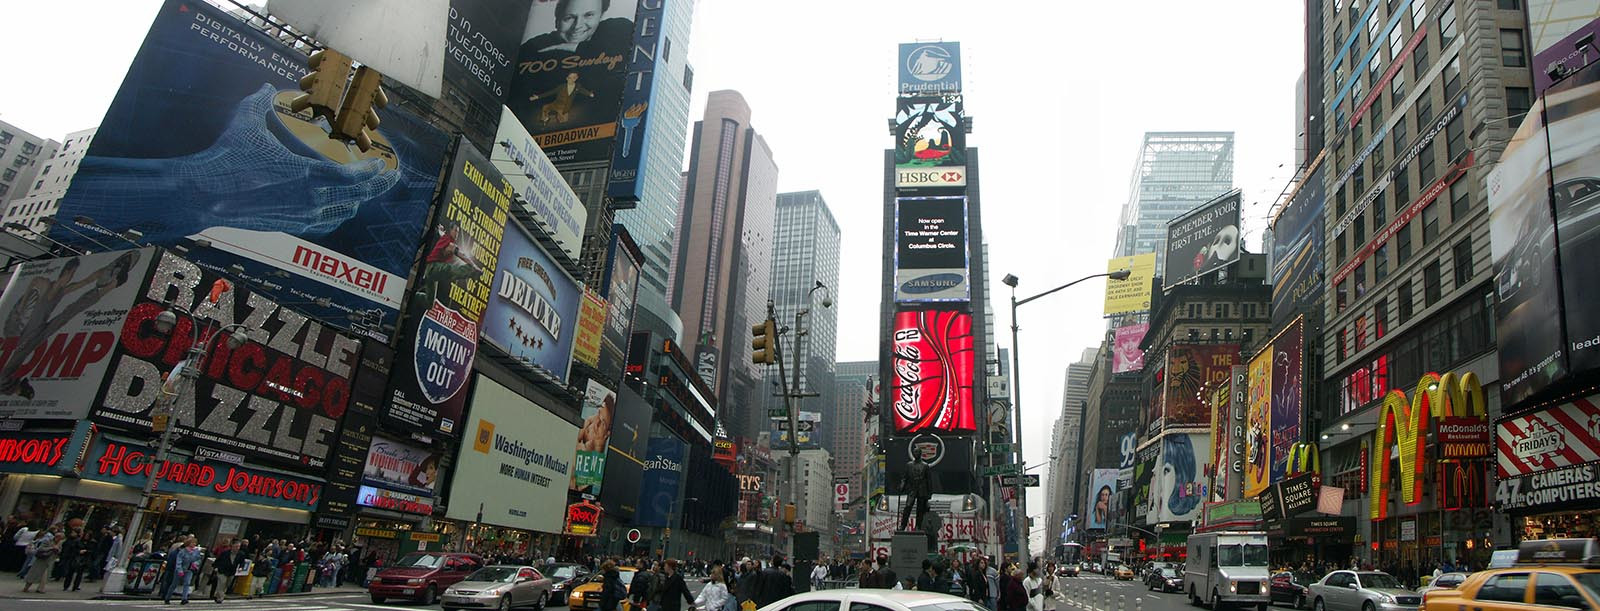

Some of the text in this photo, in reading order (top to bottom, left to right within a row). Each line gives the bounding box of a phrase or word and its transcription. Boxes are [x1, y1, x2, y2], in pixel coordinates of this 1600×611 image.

[195, 13, 264, 52] DIGITALLY
[460, 17, 471, 33] IN
[472, 32, 510, 67] STORES
[190, 22, 297, 82] PERFORMANCE.
[450, 24, 495, 74] TUESDAY,
[519, 52, 623, 74] 700 Sundays
[493, 82, 502, 96] 16
[901, 81, 959, 91] Prudential
[941, 95, 961, 103] 1:34
[544, 127, 600, 146] BROADWAY
[1399, 106, 1457, 171] mattress.com
[462, 160, 510, 212] EXHILARATING
[524, 138, 574, 208] THE UNDISPUTED
[900, 172, 939, 183] HSBC
[452, 188, 504, 240] SOUL-STIRRING
[492, 206, 507, 227] AND
[1171, 200, 1237, 240] REMEMBER YOUR
[1389, 217, 1405, 234] WALL
[447, 203, 502, 256] IT PRACTICALLY
[1171, 234, 1193, 252] FIRST
[291, 245, 388, 294] maxell
[471, 241, 497, 272] BURSTS
[477, 279, 490, 302] THE
[908, 280, 957, 288] SAMSUNG
[146, 249, 361, 380] RAZZLE
[498, 270, 561, 341] DELUXE
[423, 328, 471, 366] MOVIN'
[1212, 354, 1232, 366] THE
[121, 302, 352, 420] CHICAGO
[426, 361, 456, 390] OUT
[103, 353, 338, 461] DAZZLE
[394, 389, 406, 399] CALL
[1233, 372, 1244, 473] PALACE
[1439, 424, 1489, 434] McDonald's
[494, 433, 569, 475] Washington Mutual
[1519, 434, 1558, 452] FRIDAY'S
[98, 443, 321, 506] HOWARD JOHNSON'S
[499, 462, 552, 488] MORE HUMAN INTEREST
[575, 455, 604, 475] RENT
[1531, 466, 1593, 489] CAMERAS
[1284, 488, 1313, 504] SQUARE
[1286, 482, 1309, 495] TIMES
[1526, 482, 1600, 507] COMPUTERS
[1287, 499, 1312, 510] ALLIANCE
